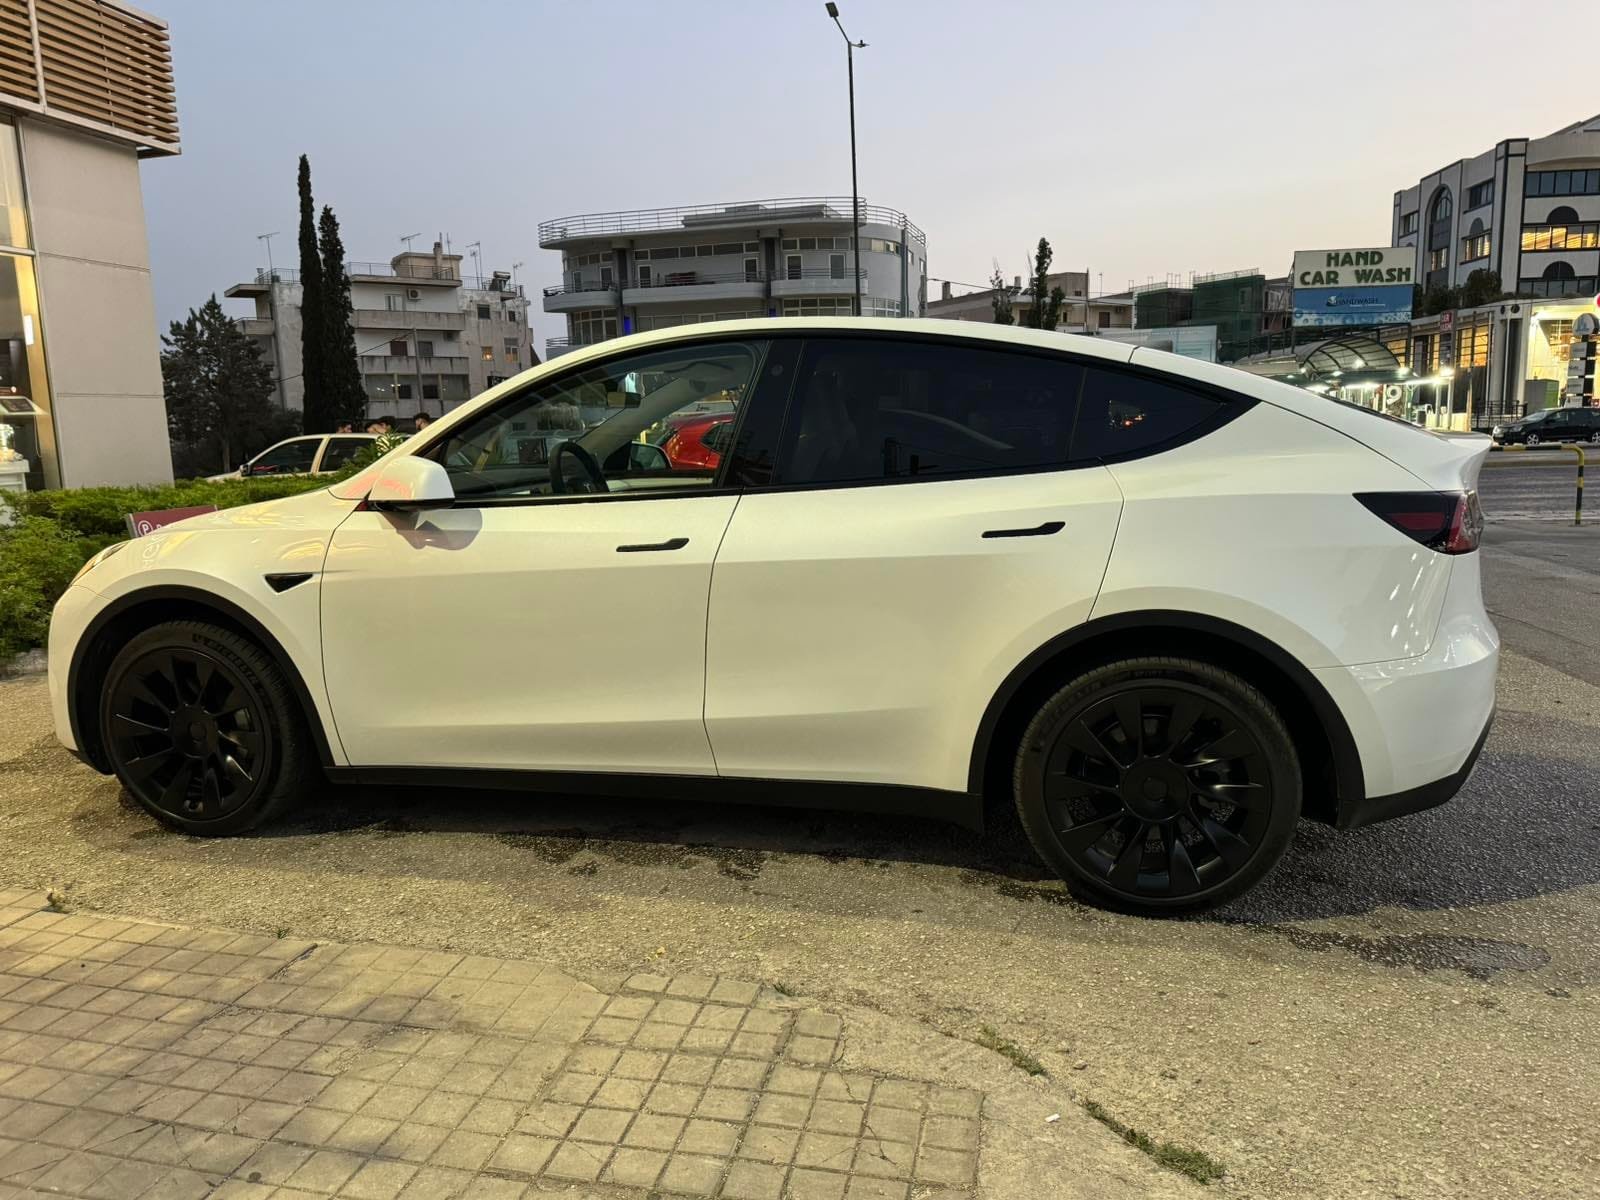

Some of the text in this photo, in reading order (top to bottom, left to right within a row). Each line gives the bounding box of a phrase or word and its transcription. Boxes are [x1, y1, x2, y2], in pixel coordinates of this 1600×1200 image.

[1326, 251, 1384, 267] HAND
[1300, 267, 1411, 285] CAR WASH
